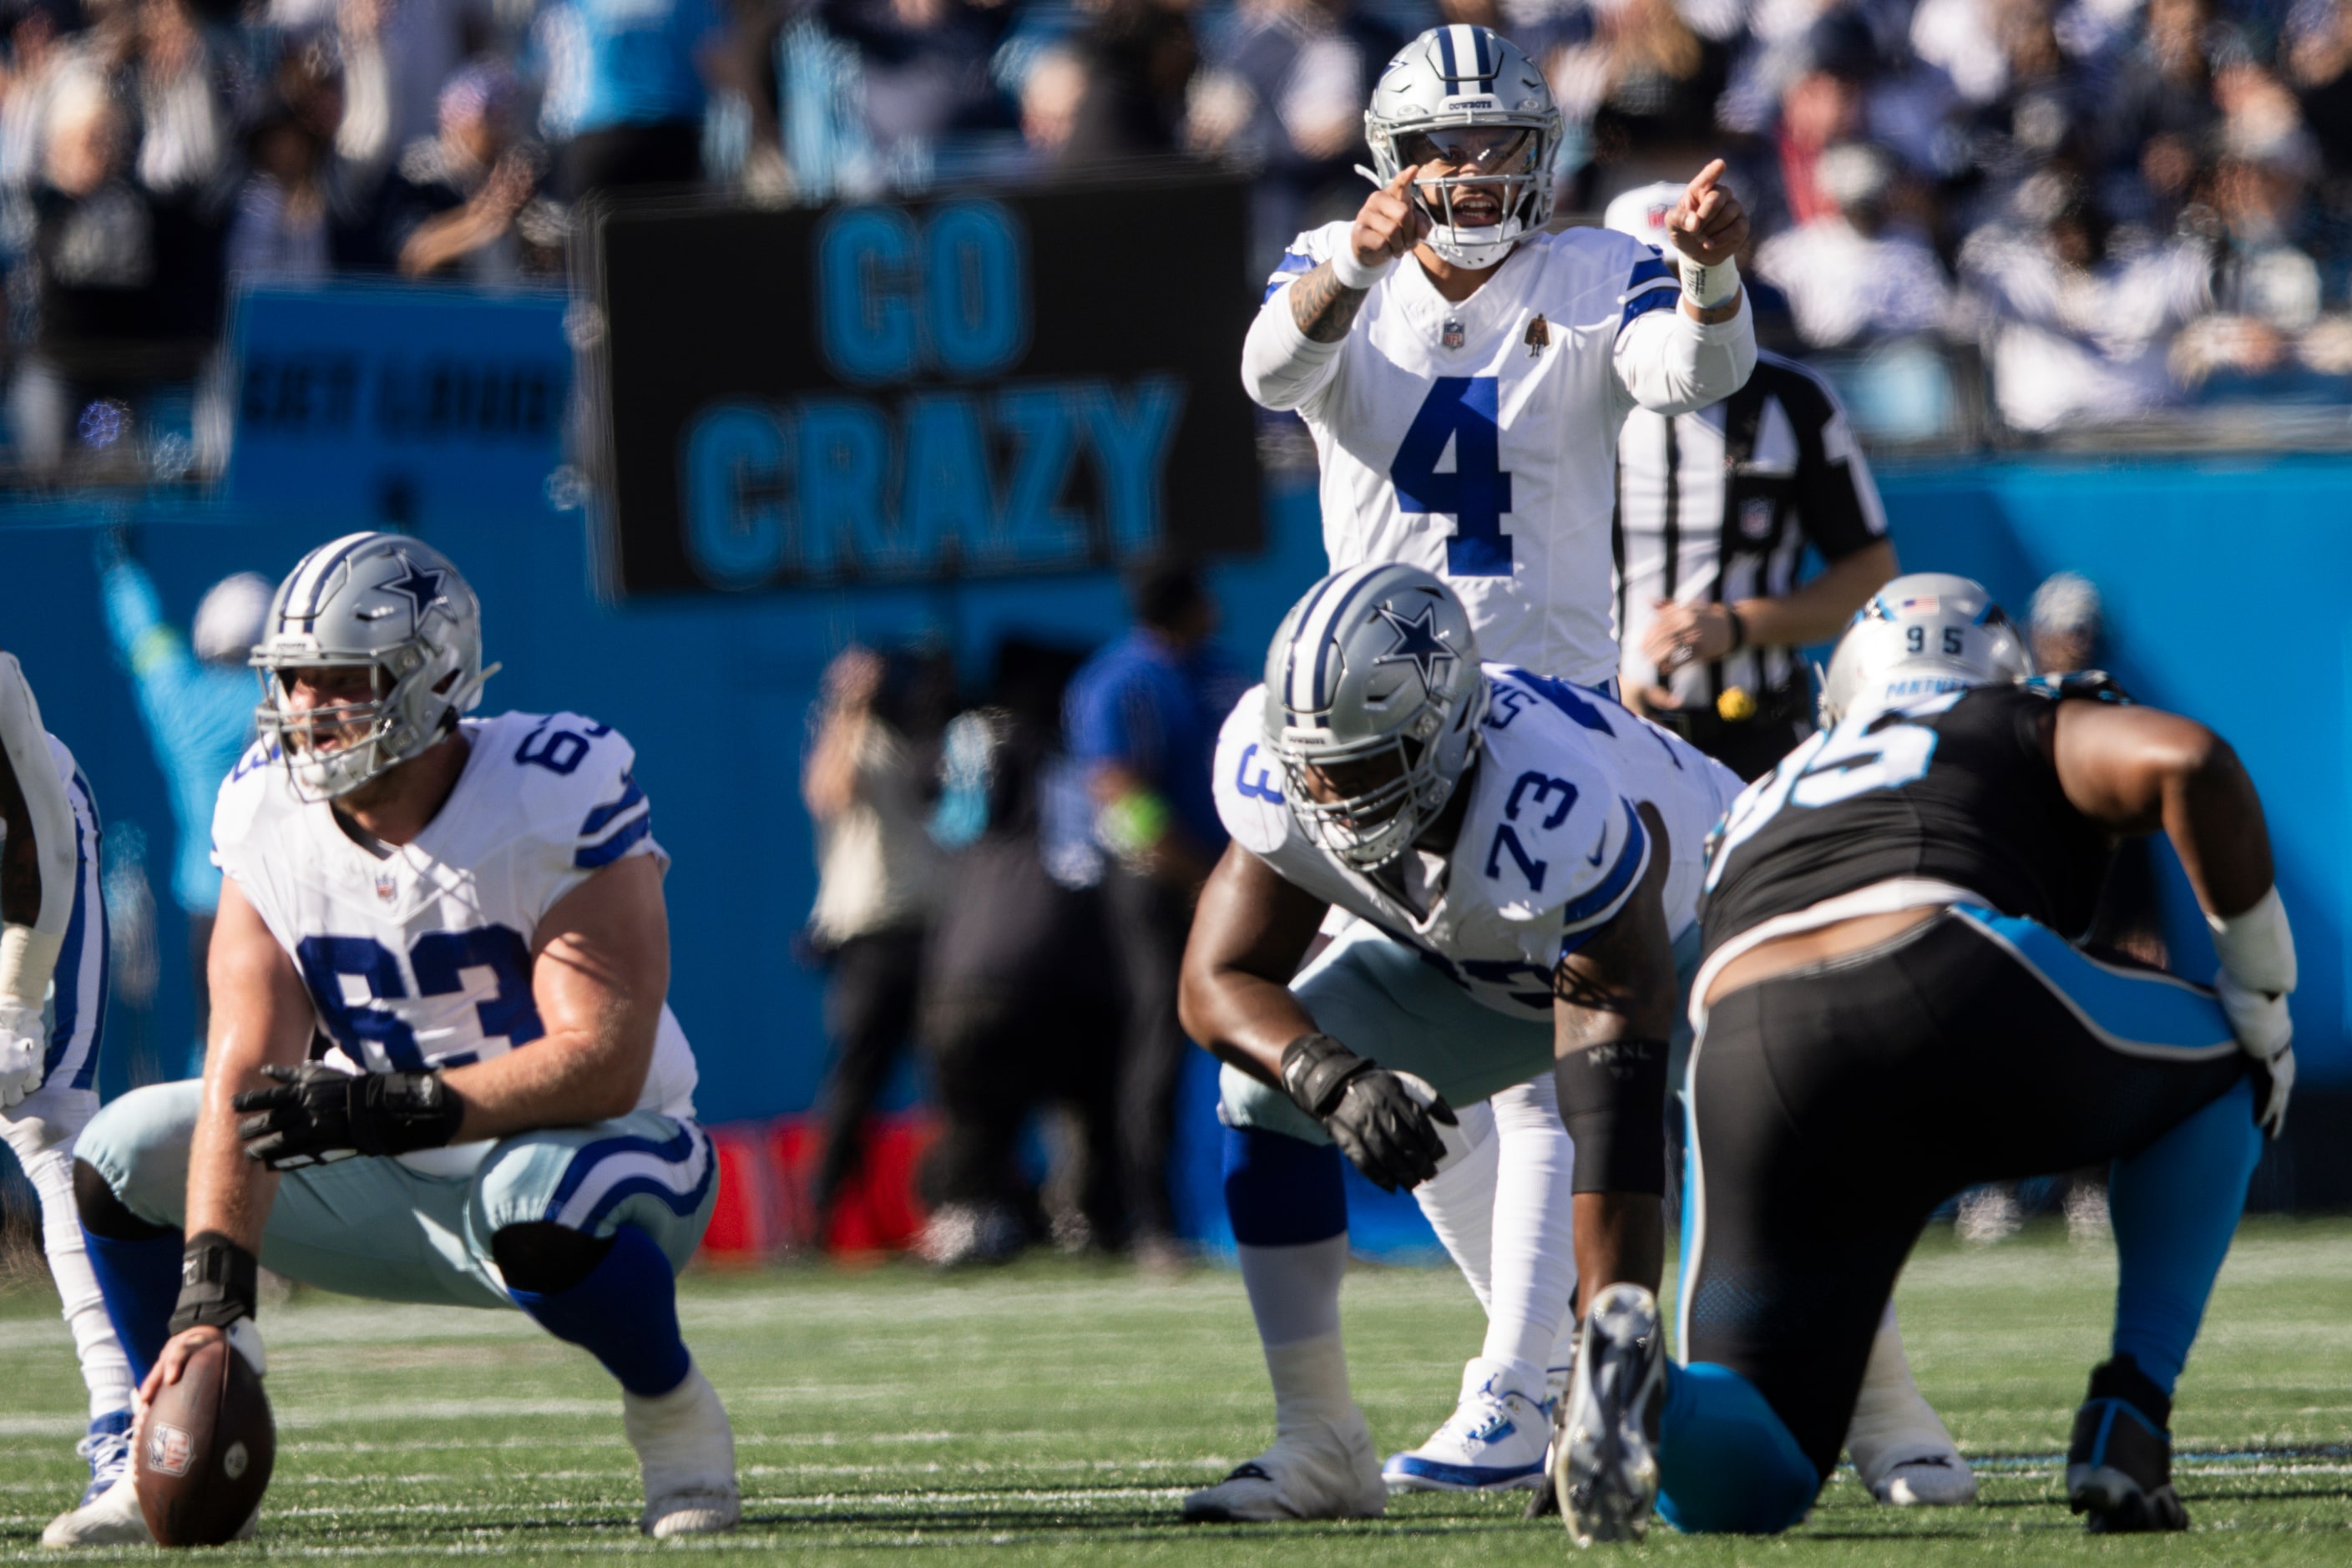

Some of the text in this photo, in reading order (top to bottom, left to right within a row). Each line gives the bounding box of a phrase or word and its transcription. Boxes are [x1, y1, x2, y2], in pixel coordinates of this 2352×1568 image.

[1449, 100, 1493, 110] COWBOYS
[685, 372, 1186, 589] CRAZY
[1389, 376, 1514, 576] 4
[1906, 626, 1964, 655] 95
[1485, 770, 1580, 893] 73
[296, 923, 546, 1074] 63
